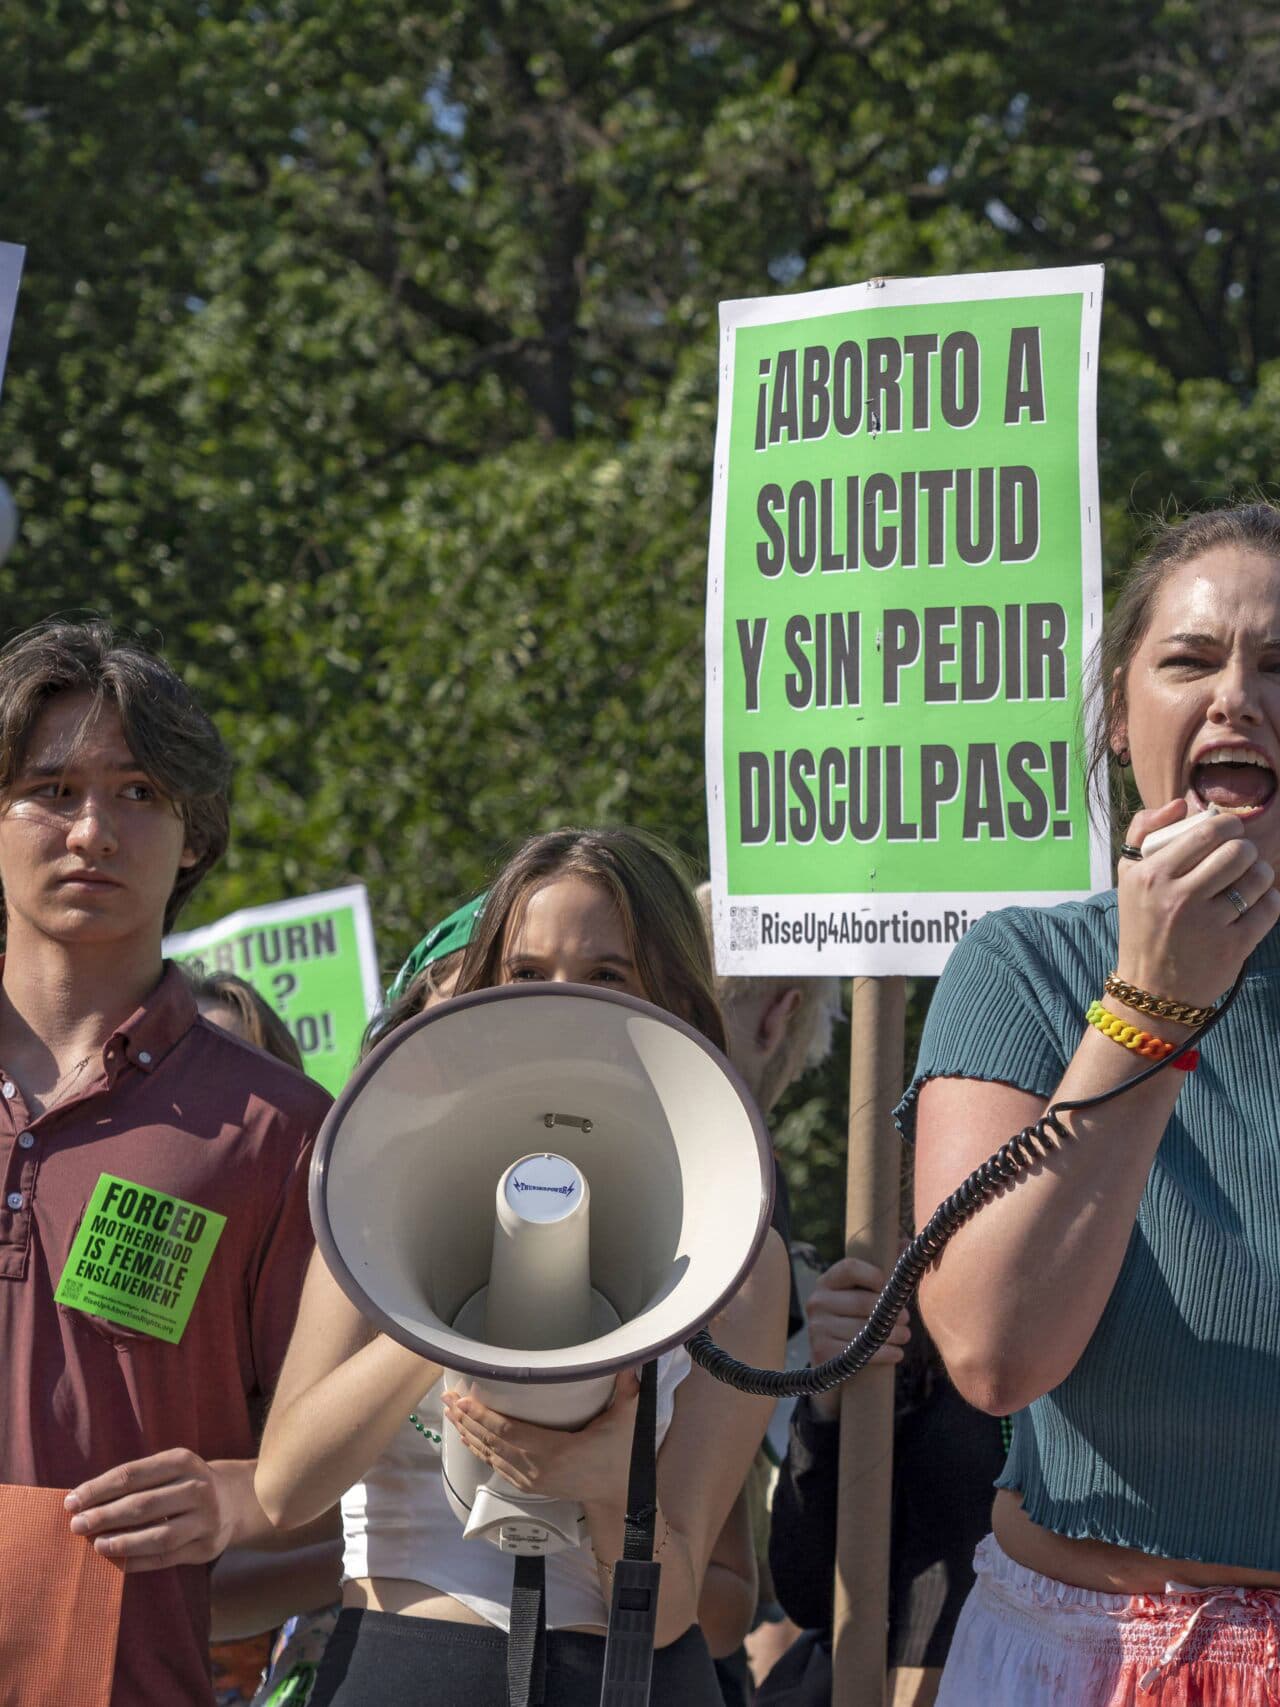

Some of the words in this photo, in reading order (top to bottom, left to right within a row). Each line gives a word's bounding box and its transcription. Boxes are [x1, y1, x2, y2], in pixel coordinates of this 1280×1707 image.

[1003, 325, 1047, 425] A
[756, 464, 1040, 579] SOLICITUD
[736, 617, 768, 713] Y
[784, 610, 862, 712] SIN
[883, 601, 1068, 706] PEDIR
[738, 740, 1073, 845] DISCULPAS!
[761, 909, 978, 952] RiseUp4AbortionRi
[283, 1012, 335, 1052] O!
[90, 1215, 193, 1265] MOTHERHOOD
[101, 1182, 208, 1244] FORCED
[75, 1259, 181, 1310] ENSLAVEMENT
[82, 1235, 106, 1260] IS
[108, 1243, 188, 1291] FEMALE
